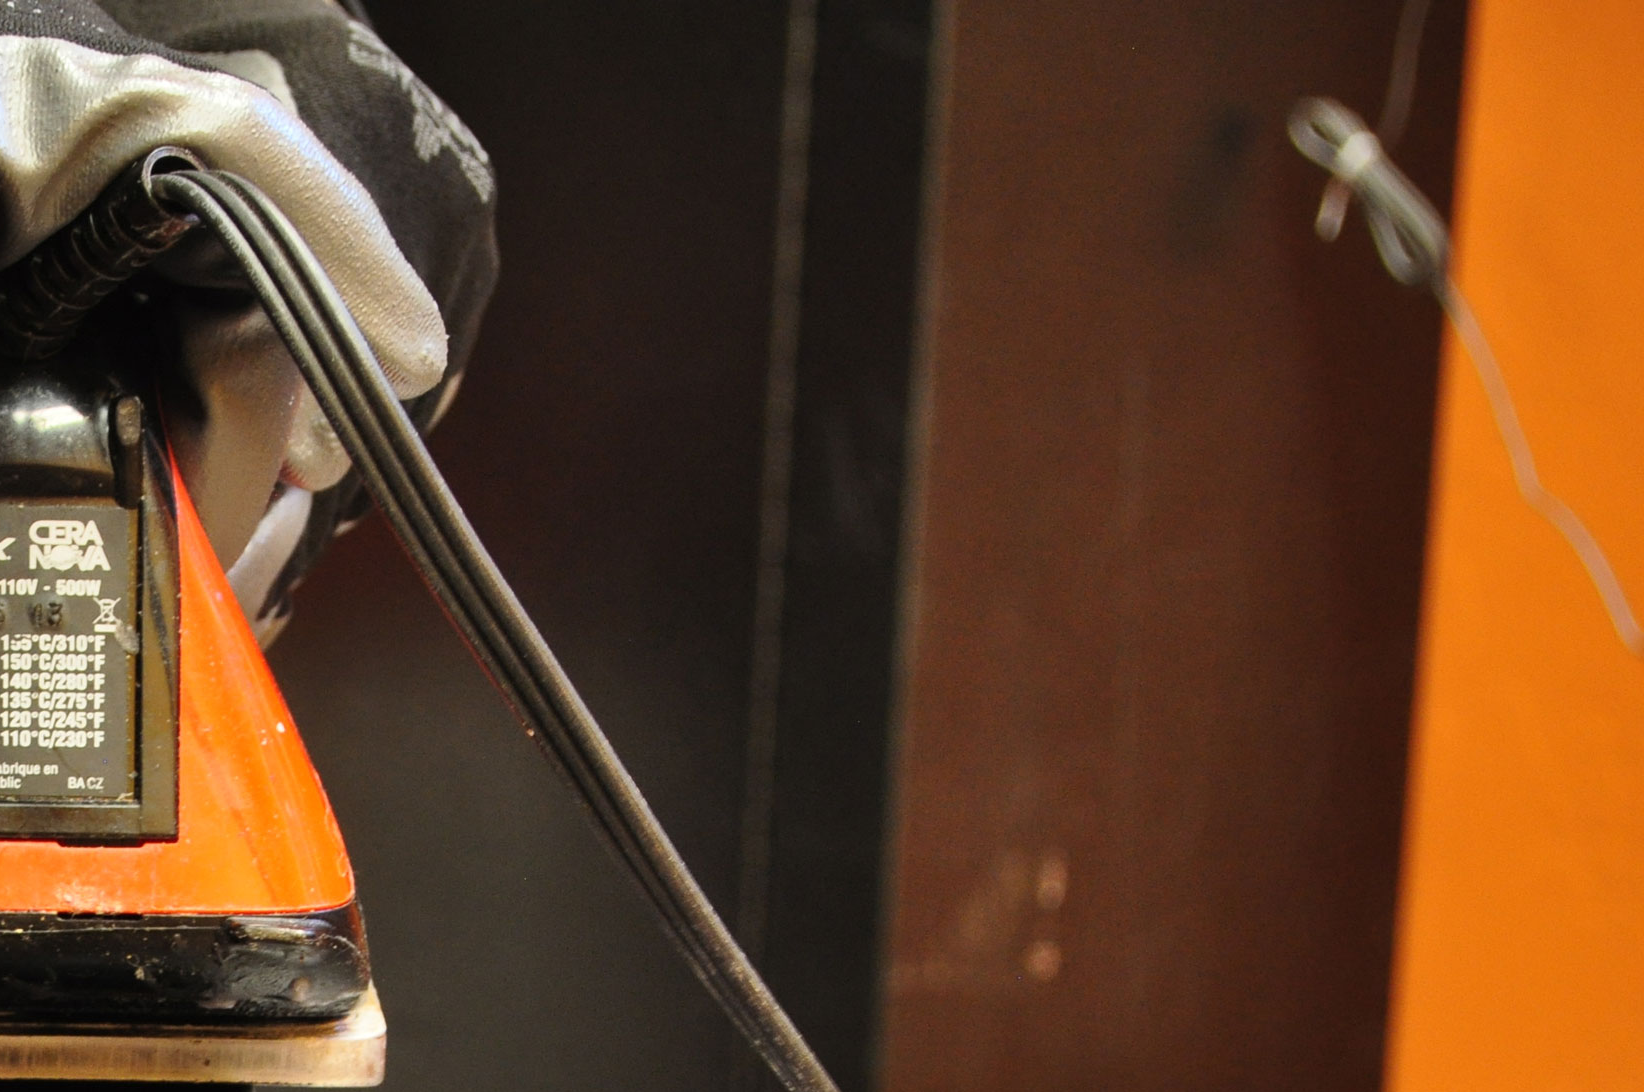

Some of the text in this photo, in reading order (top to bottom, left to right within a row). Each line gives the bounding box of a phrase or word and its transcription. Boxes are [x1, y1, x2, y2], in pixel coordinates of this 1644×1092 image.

[29, 520, 104, 545] CERA
[29, 545, 111, 571] NOVA
[55, 579, 101, 596] 500W
[0, 653, 105, 672] 150°C/300°F
[0, 672, 105, 691] 140°C/280°F
[0, 691, 105, 711] 135°C/275°F
[0, 710, 105, 730] 120°C/245°F
[0, 729, 105, 749] 110°C/230°F
[43, 764, 59, 775] en
[67, 777, 104, 790] BA CZ
